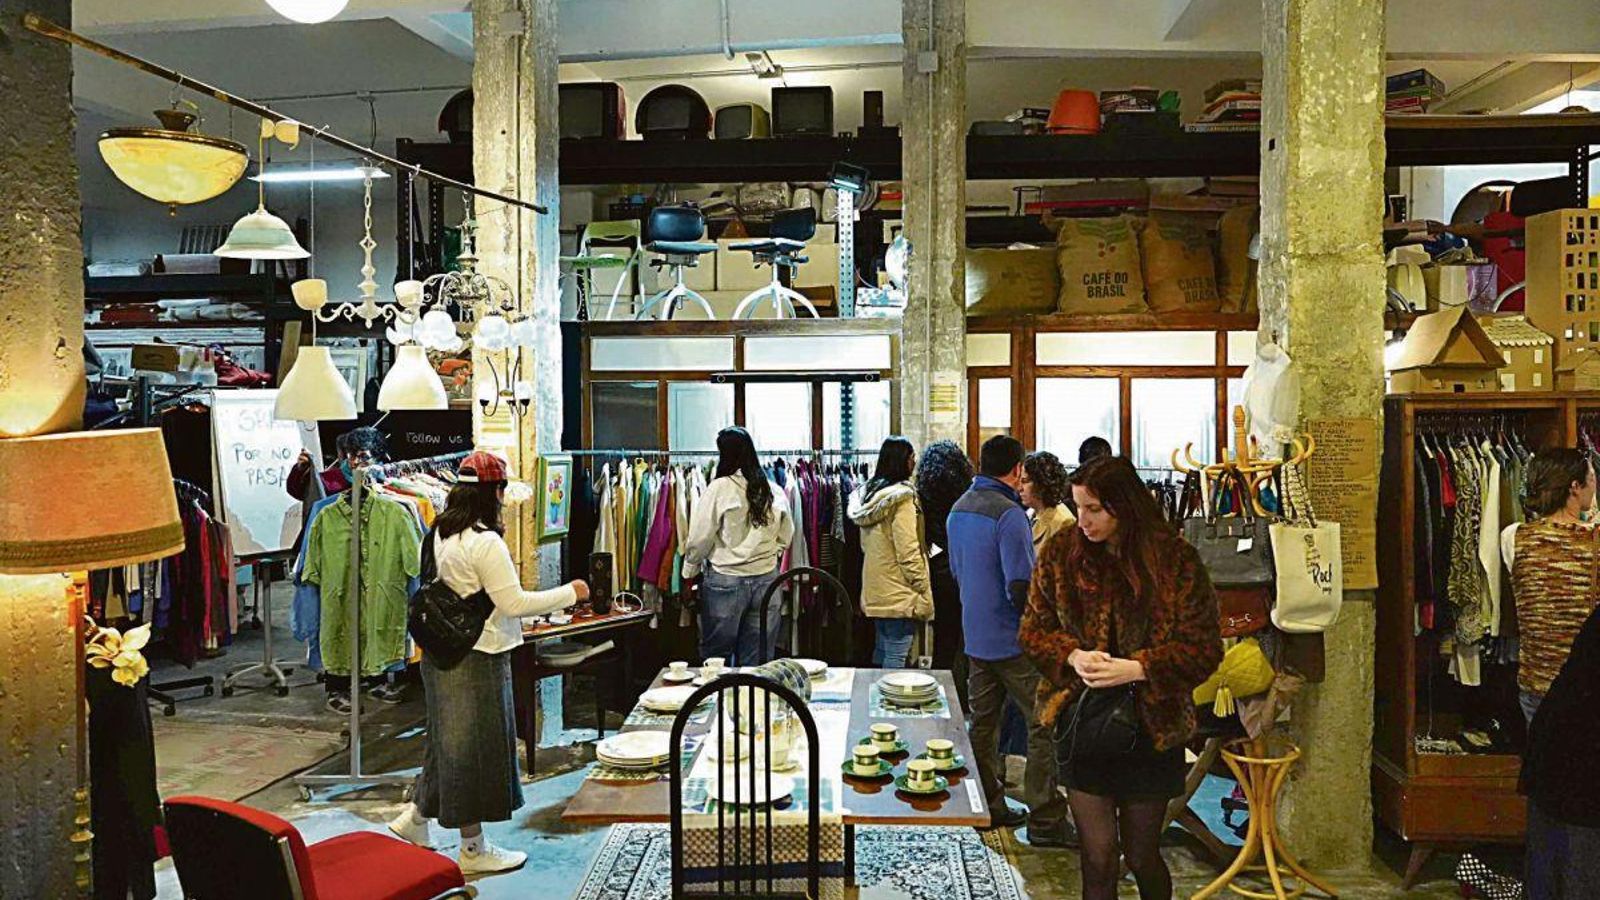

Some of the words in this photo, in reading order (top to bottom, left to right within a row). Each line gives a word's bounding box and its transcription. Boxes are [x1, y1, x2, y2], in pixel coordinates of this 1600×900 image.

[1083, 269, 1111, 285] CAFÉ
[1114, 271, 1128, 284] DO
[1087, 284, 1126, 299] BRASIL
[271, 447, 292, 460] NO
